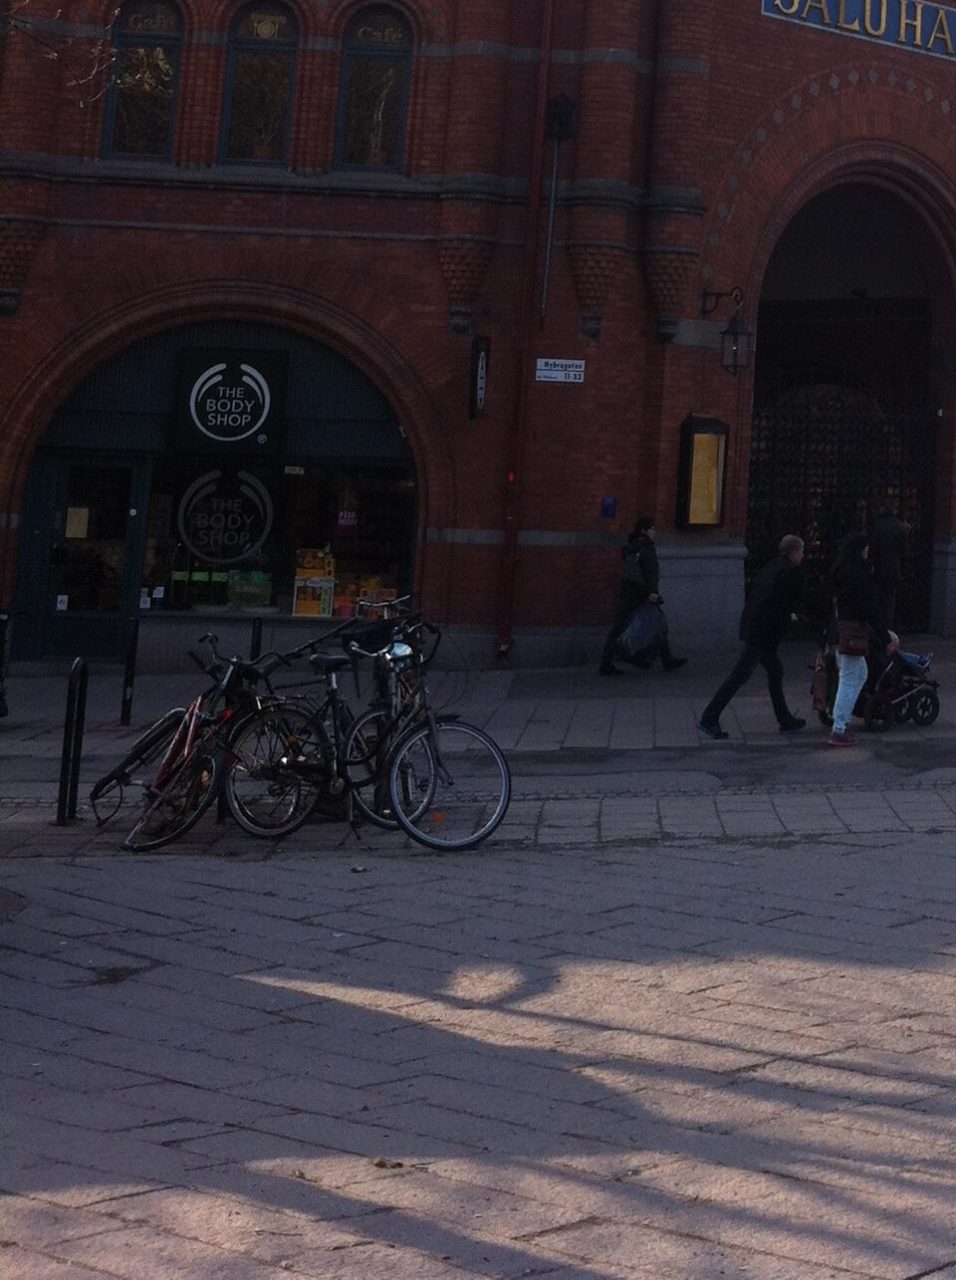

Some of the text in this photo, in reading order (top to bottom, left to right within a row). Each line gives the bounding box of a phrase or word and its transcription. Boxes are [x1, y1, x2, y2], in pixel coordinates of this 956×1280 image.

[357, 26, 403, 43] Café
[217, 386, 245, 399] THE
[206, 398, 255, 413] BODY
[207, 413, 251, 427] SHOP
[210, 498, 243, 512] THE
[197, 513, 256, 531] BODY
[198, 530, 250, 545] SHOP
